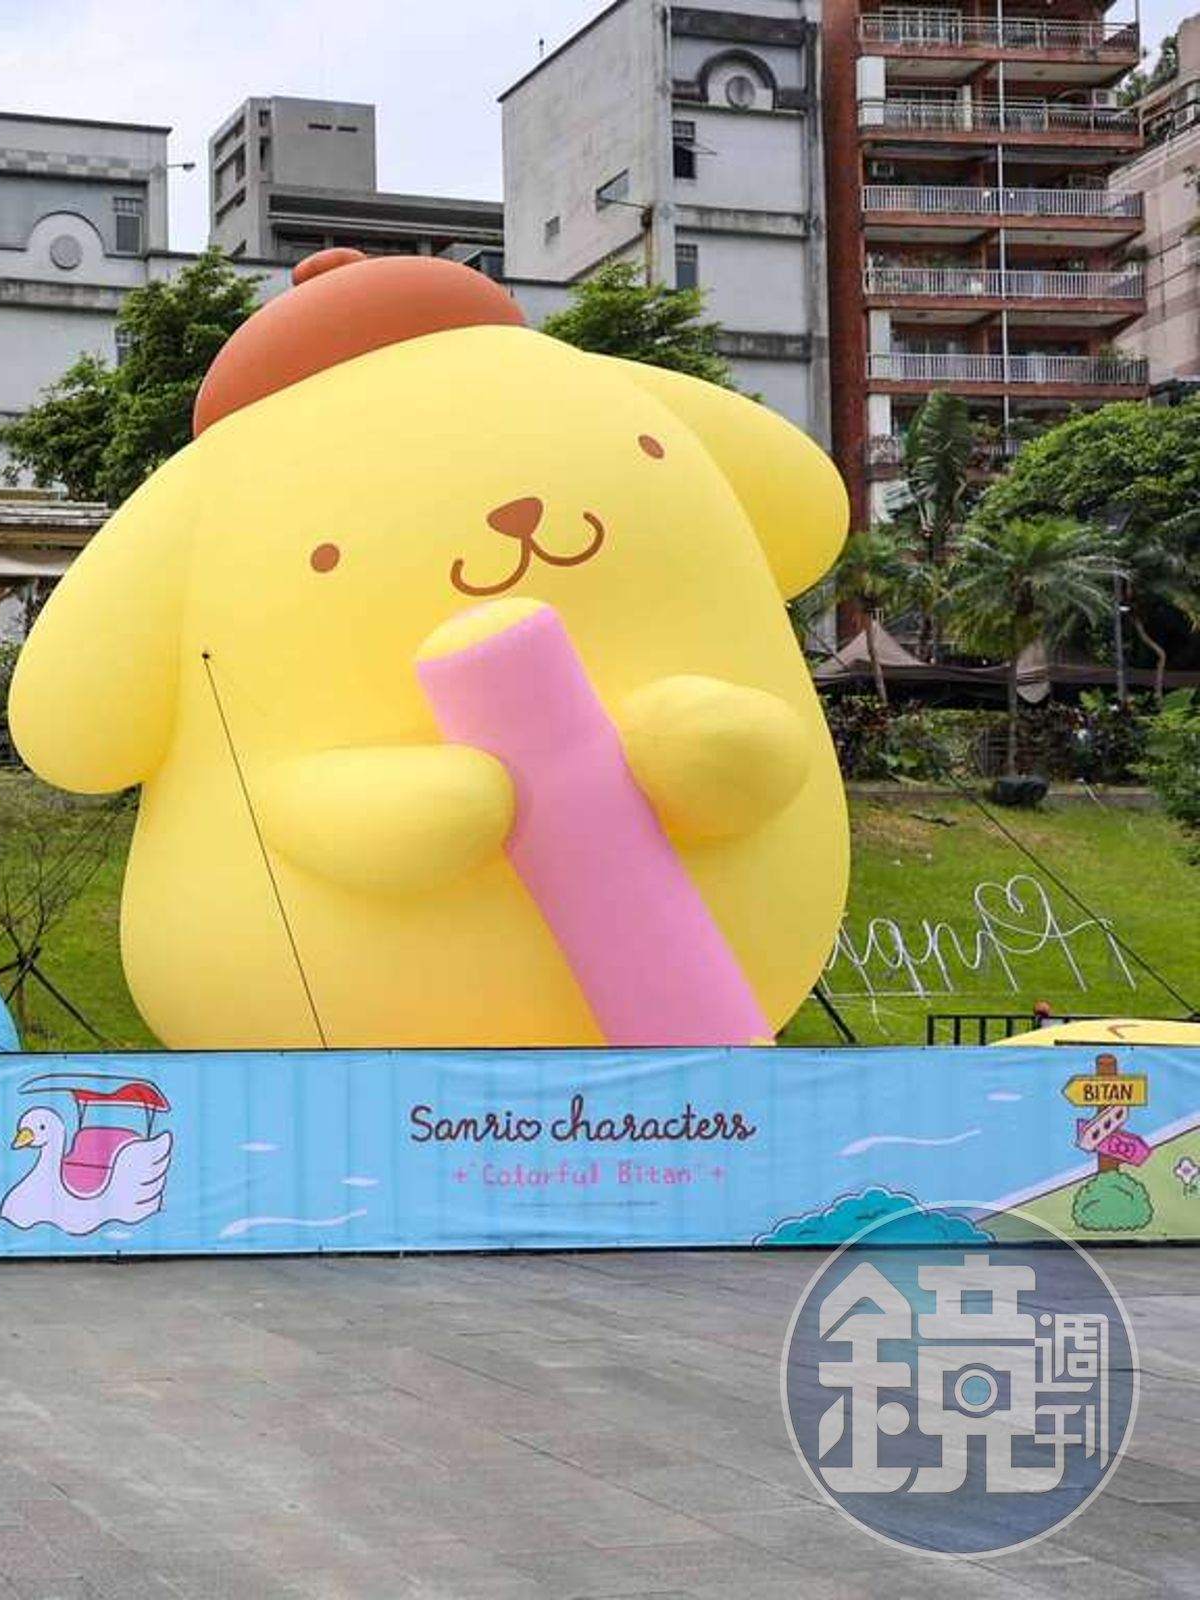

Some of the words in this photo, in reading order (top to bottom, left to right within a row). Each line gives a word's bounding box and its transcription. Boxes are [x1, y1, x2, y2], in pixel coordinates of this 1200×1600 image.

[1083, 1083, 1134, 1101] BITAN
[410, 1104, 542, 1142] Sanrio
[551, 1094, 757, 1142] characters
[482, 1160, 601, 1186] Colorful
[617, 1160, 693, 1185] Bitan
